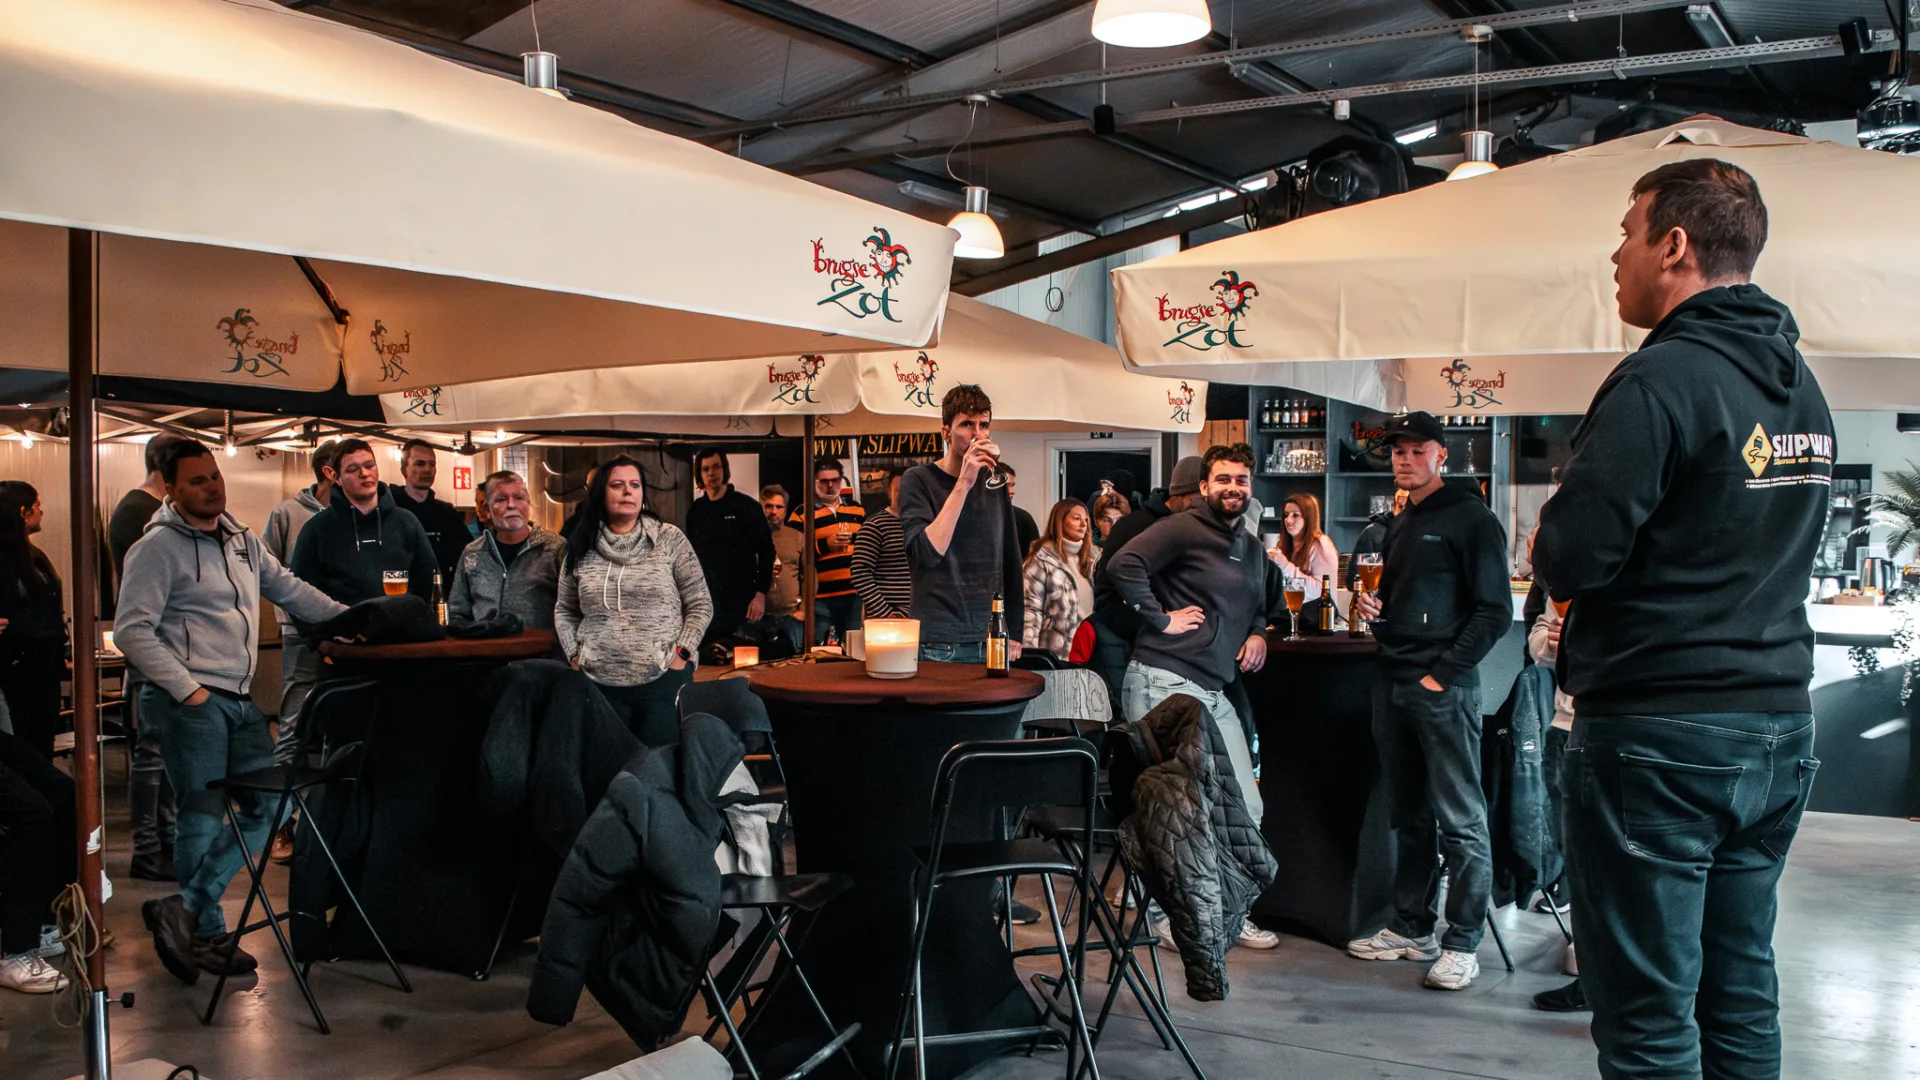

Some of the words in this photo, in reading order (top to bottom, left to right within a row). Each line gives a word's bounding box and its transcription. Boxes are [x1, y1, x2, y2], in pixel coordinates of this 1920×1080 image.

[810, 237, 871, 286] brugse
[817, 278, 903, 323] Zot
[1154, 293, 1217, 328] brugse
[1163, 320, 1254, 351] Zot
[767, 362, 802, 388] brugse
[403, 398, 444, 417] Zot
[771, 383, 821, 405] Zot
[904, 384, 939, 407] Zot
